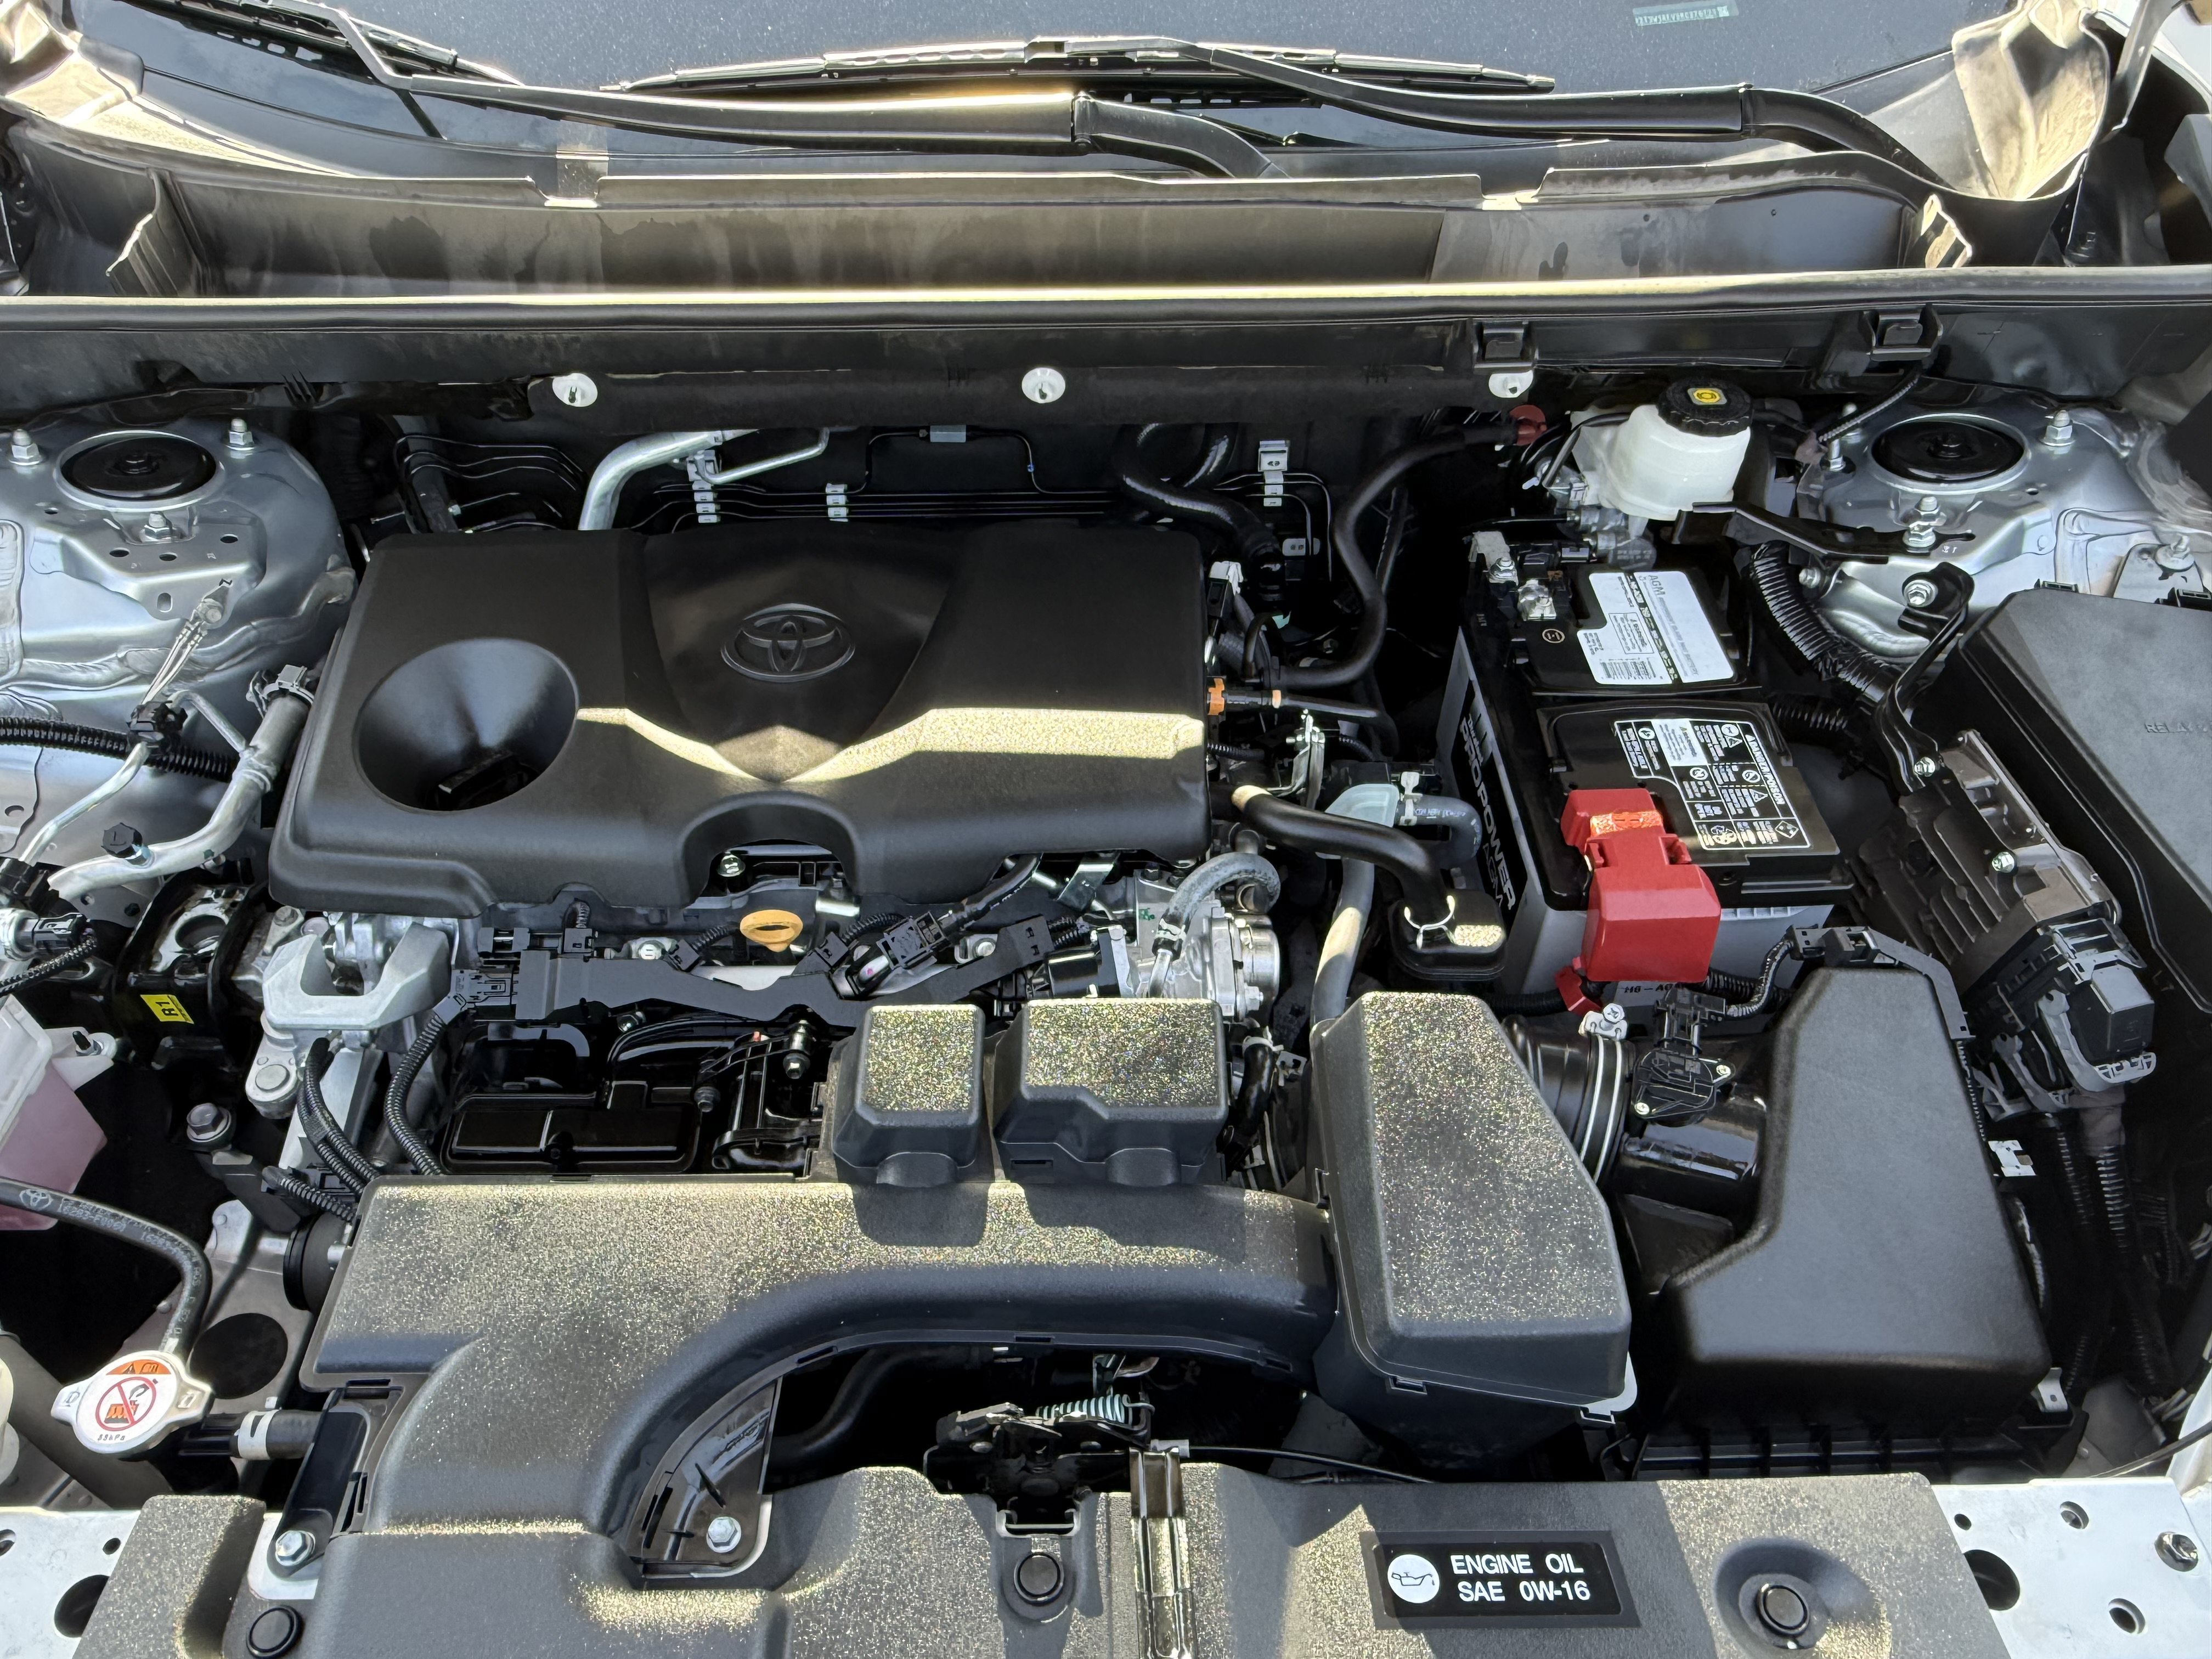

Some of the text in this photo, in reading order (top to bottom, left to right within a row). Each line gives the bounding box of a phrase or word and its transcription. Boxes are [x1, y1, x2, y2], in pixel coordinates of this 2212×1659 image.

[1648, 575, 1666, 595] AGM
[1460, 716, 1516, 911] PROPOWER
[156, 1001, 179, 1017] R1
[1450, 1553, 1584, 1575] ENGINE OIL
[1457, 1580, 1590, 1602] SAE 0W-16
